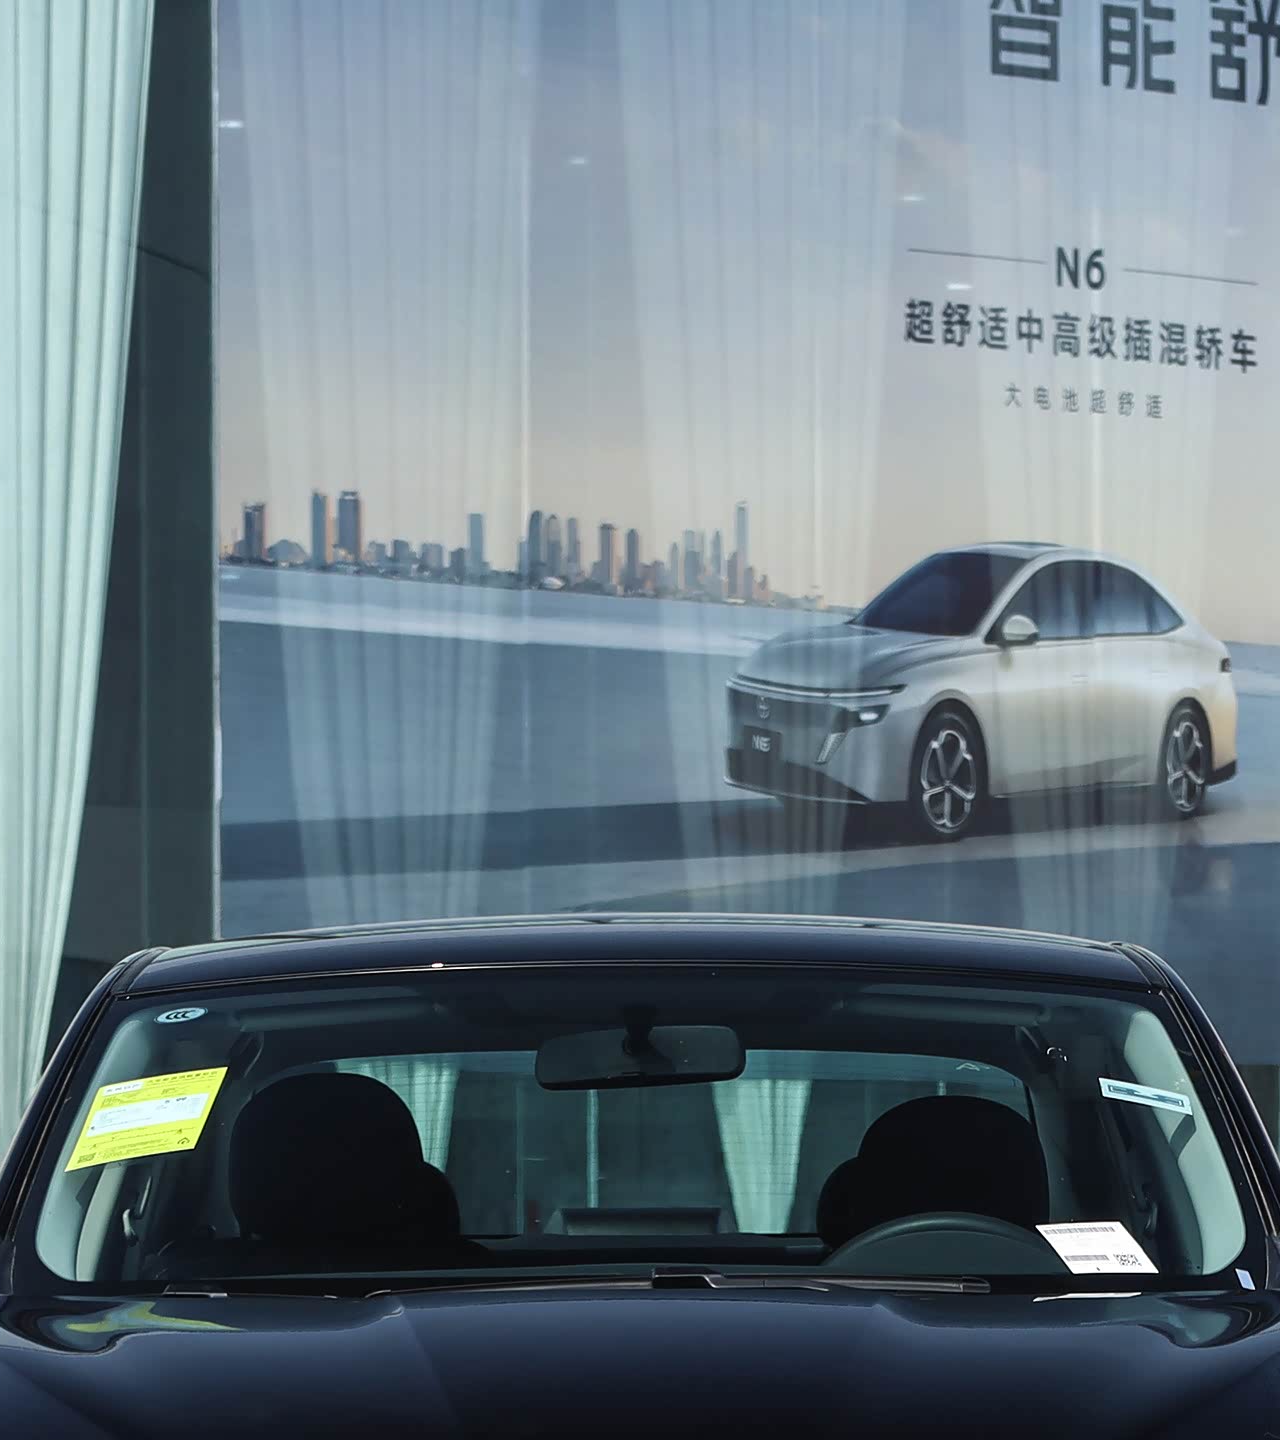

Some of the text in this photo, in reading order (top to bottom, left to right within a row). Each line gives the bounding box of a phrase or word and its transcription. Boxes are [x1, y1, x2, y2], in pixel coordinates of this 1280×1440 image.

[1055, 247, 1106, 290] N6
[904, 298, 1259, 374] 超舒适中高级插混轿车
